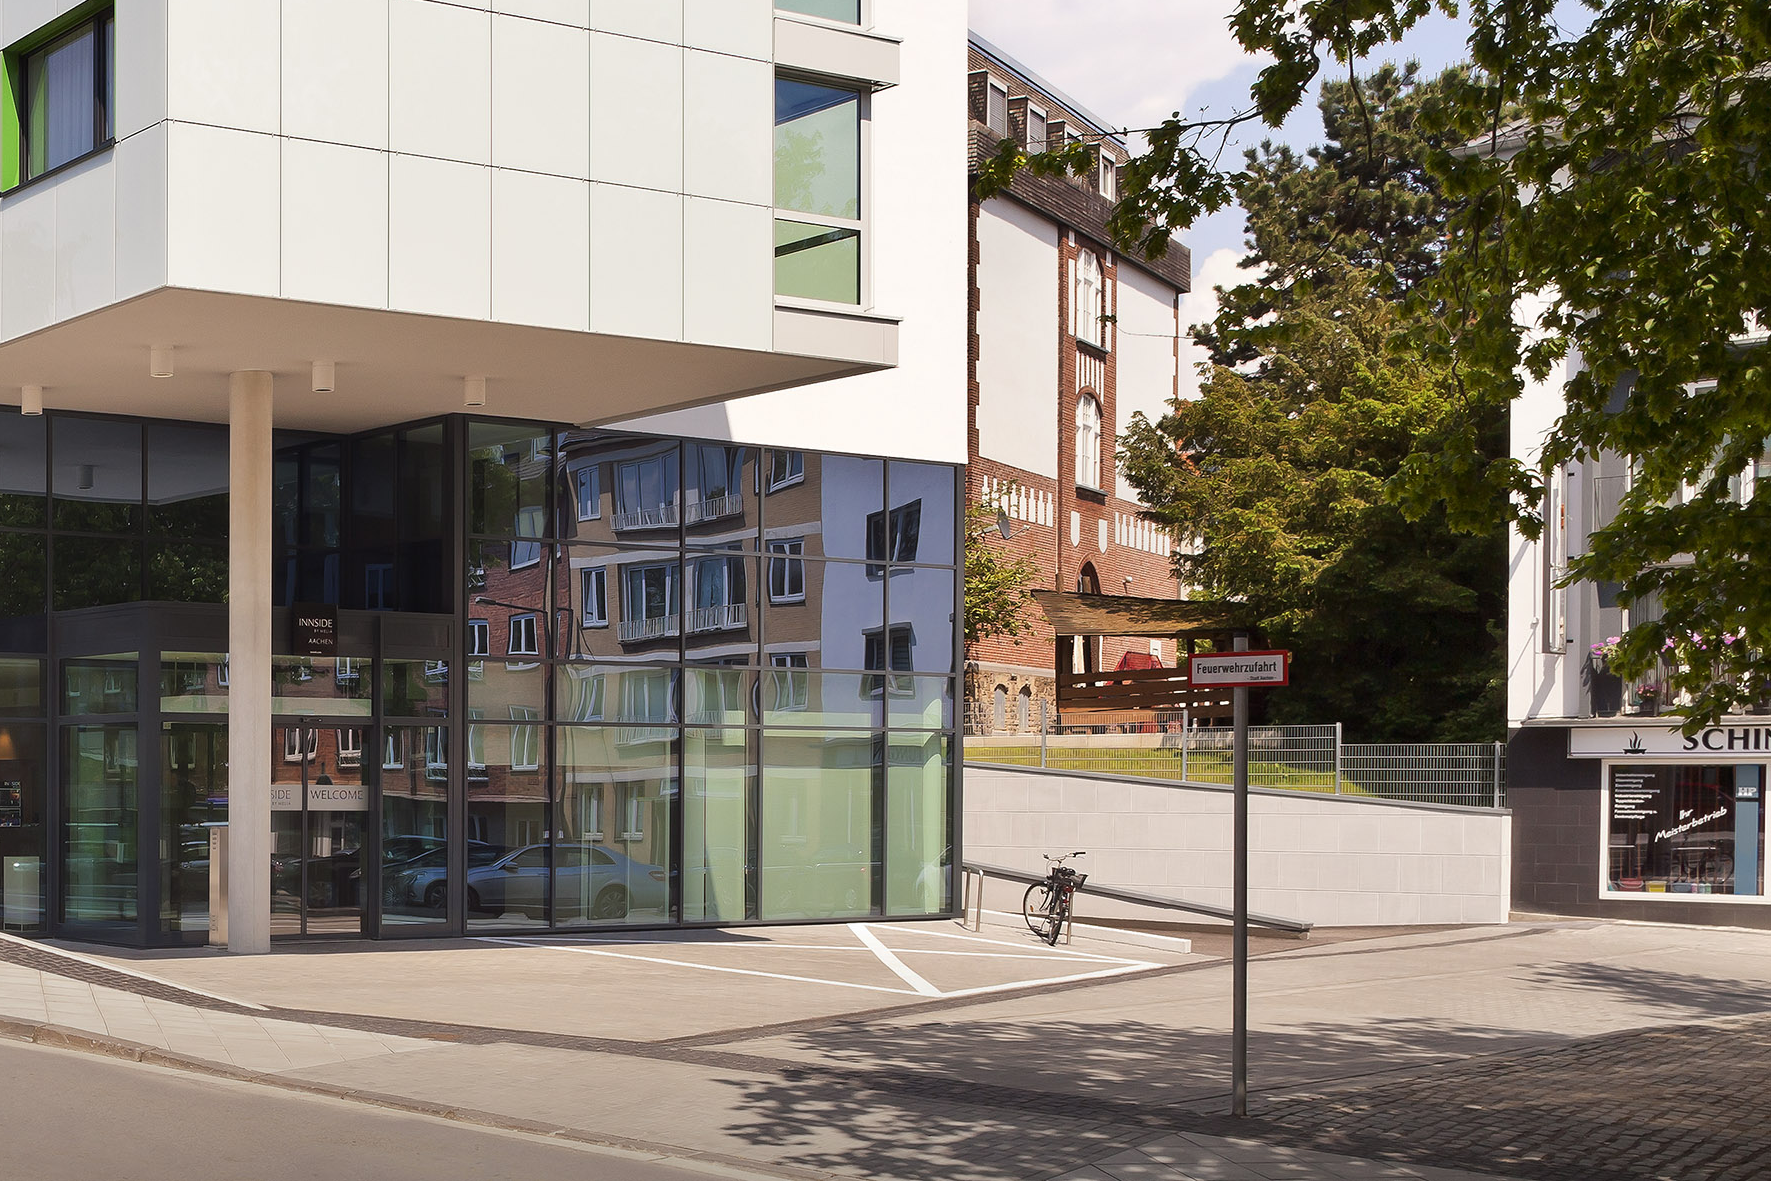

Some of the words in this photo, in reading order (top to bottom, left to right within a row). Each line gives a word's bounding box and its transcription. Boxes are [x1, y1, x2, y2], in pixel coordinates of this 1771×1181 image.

[298, 618, 333, 628] INNSIDE
[1196, 661, 1277, 674] Feuerwehrzufahrt
[310, 789, 364, 800] WELCOME
[1679, 809, 1693, 820] Ihr
[1654, 806, 1728, 843] Meisterbetrieb
